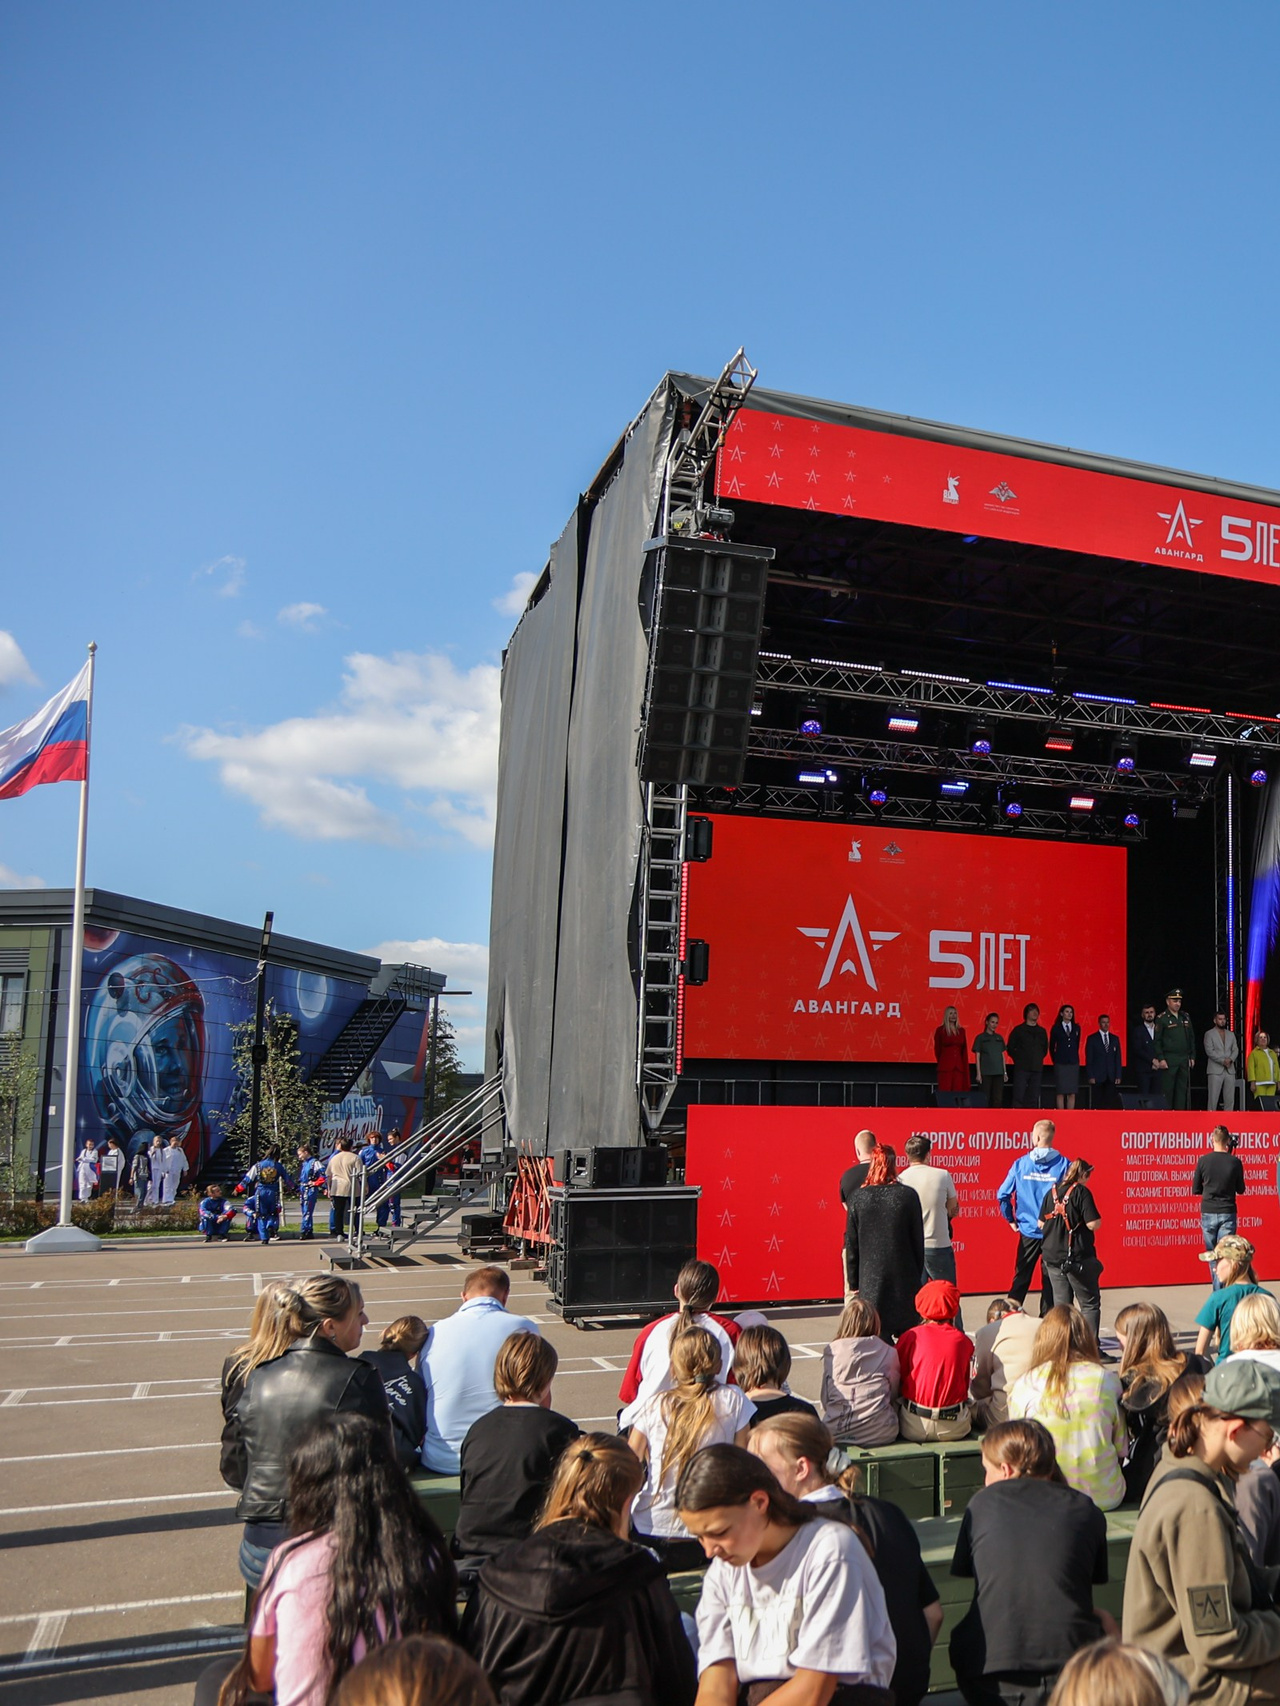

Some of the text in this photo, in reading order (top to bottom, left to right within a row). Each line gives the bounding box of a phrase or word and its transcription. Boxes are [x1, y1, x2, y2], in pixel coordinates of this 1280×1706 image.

[1154, 546, 1204, 562] АВАНГАРД
[793, 999, 901, 1018] АВАНГАРД
[911, 1131, 965, 1150] РПУС
[1206, 1131, 1270, 1149] КЛЕКС
[933, 1155, 980, 1168] ПРОДУКЦИЯ
[1126, 1154, 1185, 1165] МАСТЕР-КЛАССЫ
[1126, 1187, 1162, 1198] ОКАЗАНИЕ
[1163, 1184, 1189, 1197] ПЕРВОЙ
[1126, 1219, 1179, 1230] МАСТЕР-КЛАСС
